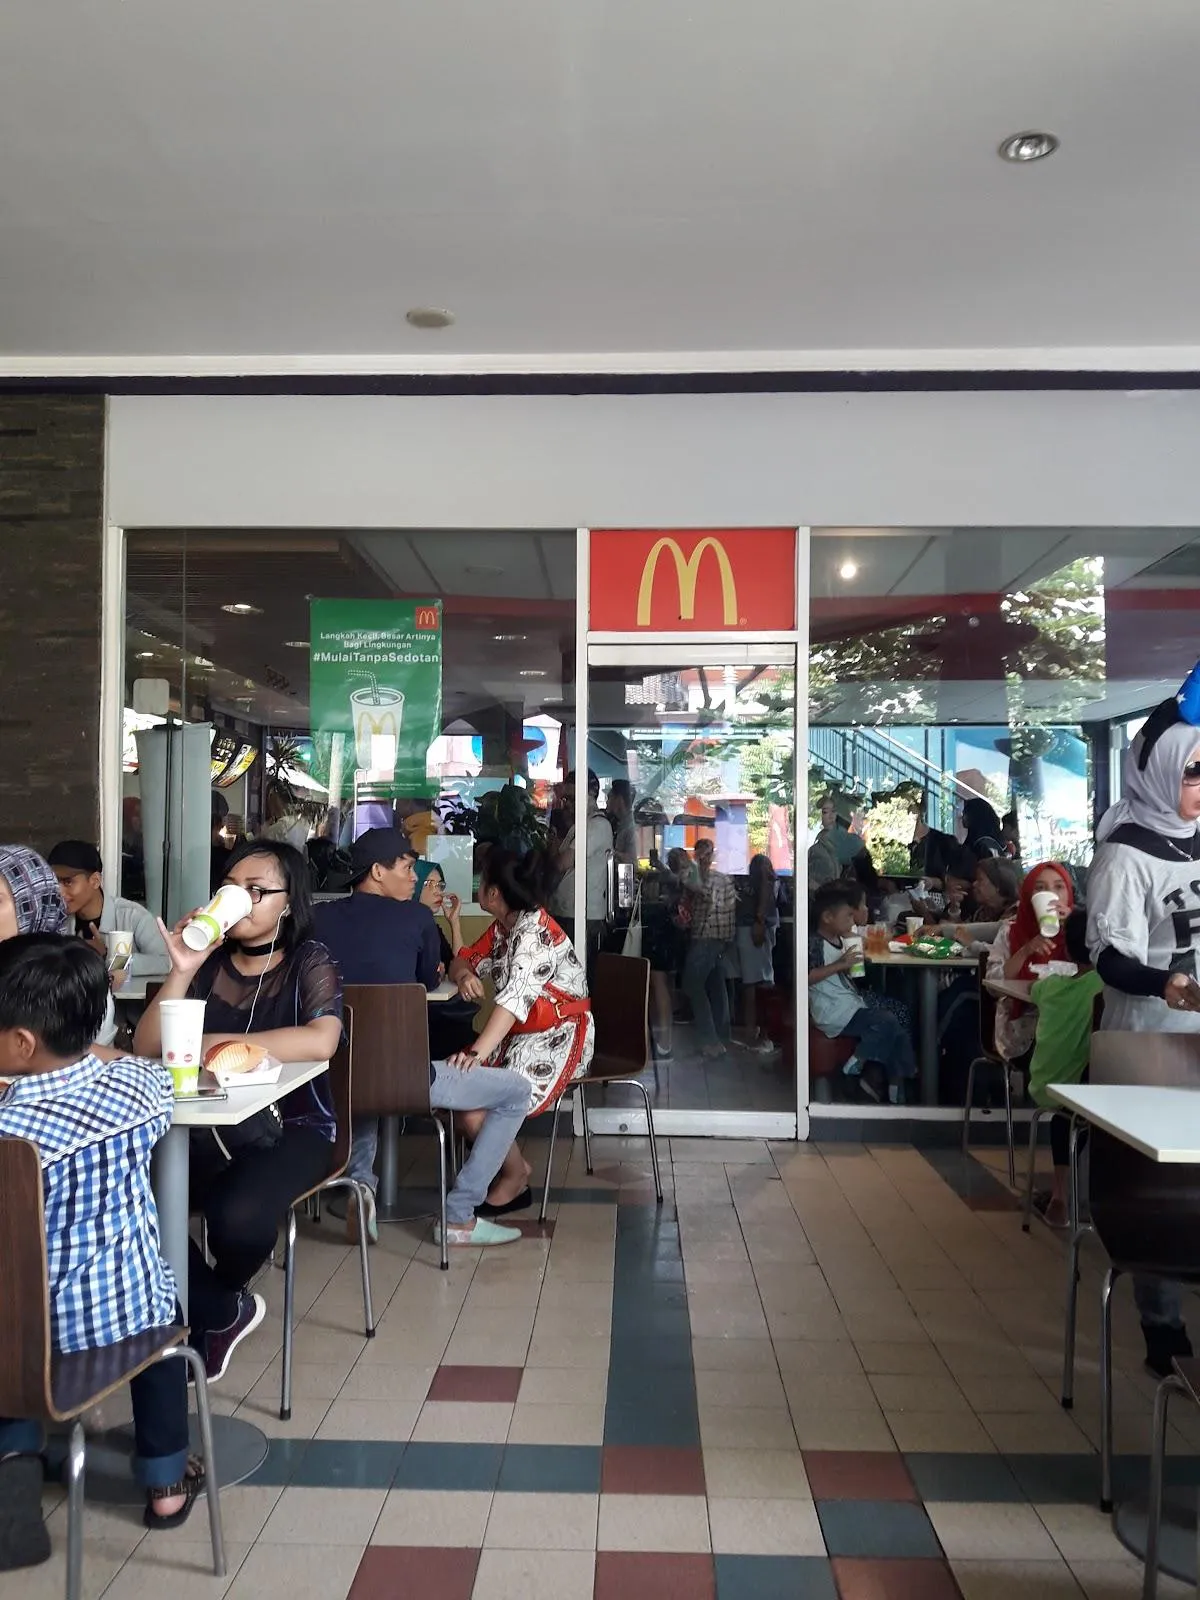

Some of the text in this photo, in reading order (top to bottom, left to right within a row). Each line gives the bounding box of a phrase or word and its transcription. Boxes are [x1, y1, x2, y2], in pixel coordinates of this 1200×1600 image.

[320, 632, 355, 641] Langkah
[405, 633, 436, 641] Artinya
[343, 641, 412, 649] Bagi Lingkungan
[313, 652, 439, 664] #MulaiTanpaSedotan
